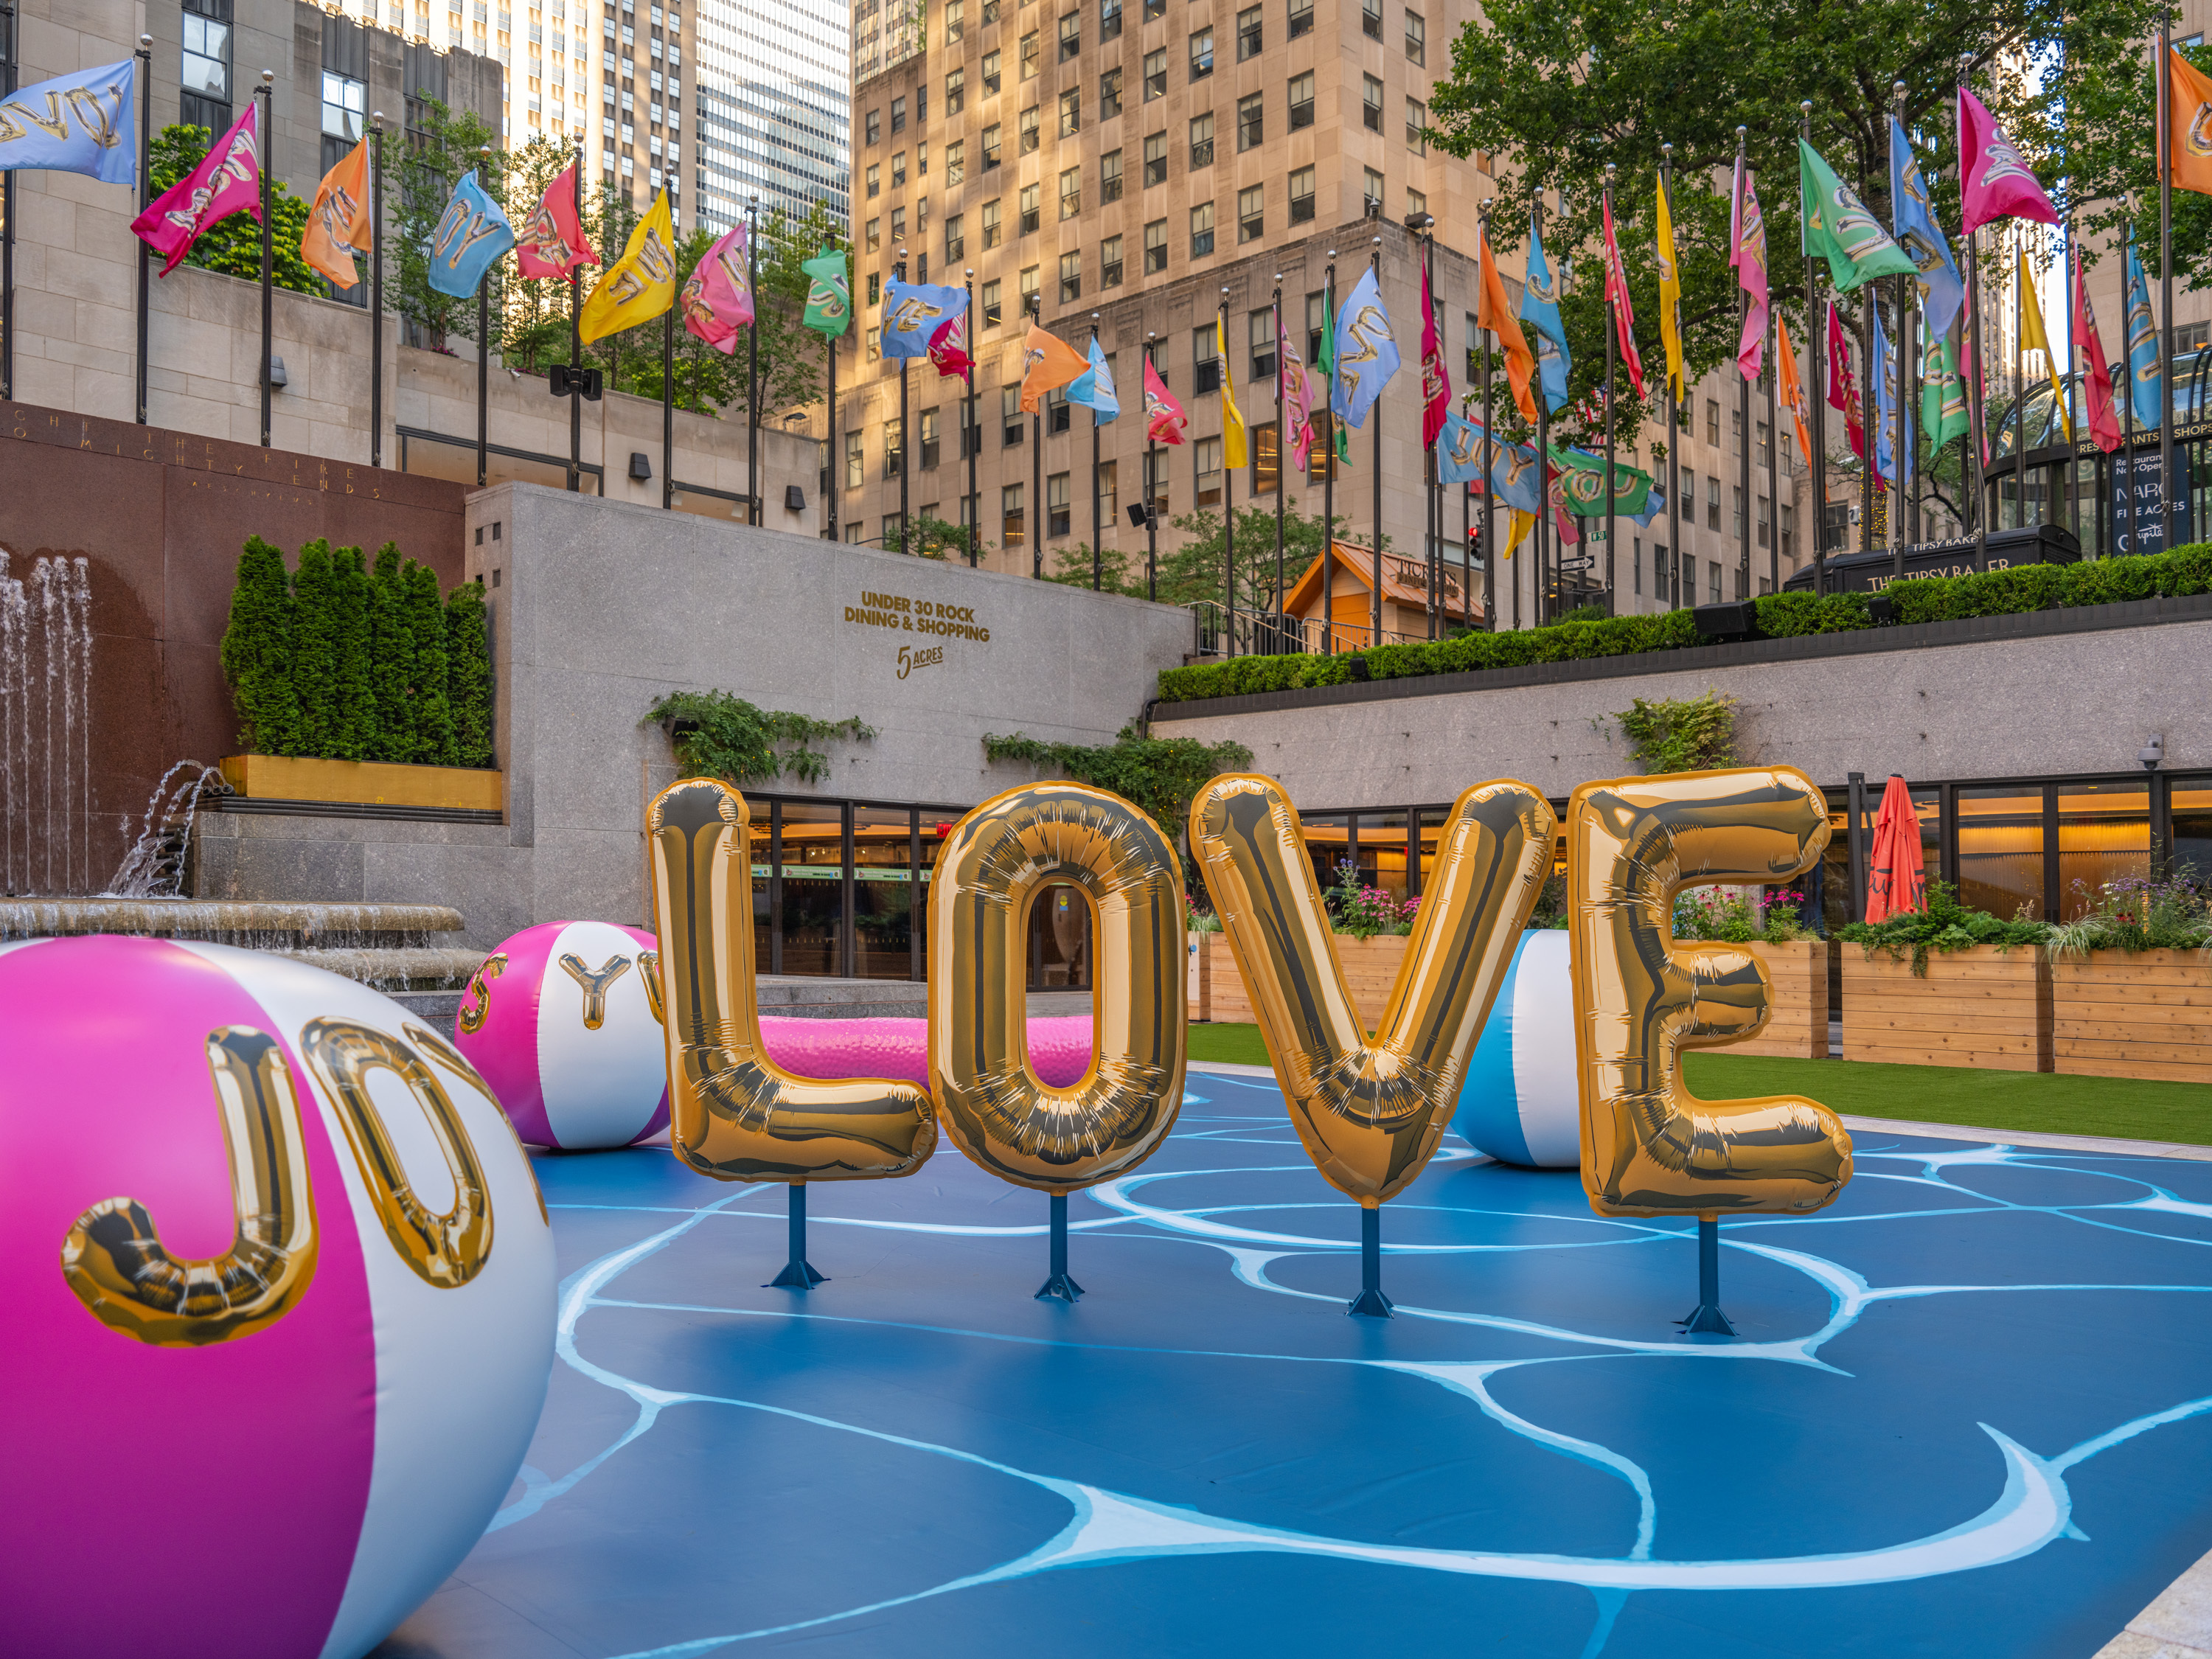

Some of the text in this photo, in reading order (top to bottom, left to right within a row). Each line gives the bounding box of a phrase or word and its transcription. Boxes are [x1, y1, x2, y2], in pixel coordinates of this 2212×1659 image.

[1450, 425, 1535, 486] JOY
[2117, 507, 2142, 518] FIE
[1912, 540, 1944, 552] TIPSY
[1397, 559, 1457, 587] TICKTS
[1952, 558, 2009, 579] BAER
[861, 591, 975, 623] UNDER 30 ROCK
[844, 606, 990, 642] DINING & SHOPPING
[897, 645, 943, 680] 5 ACRES
[647, 765, 1853, 1218] LOVE
